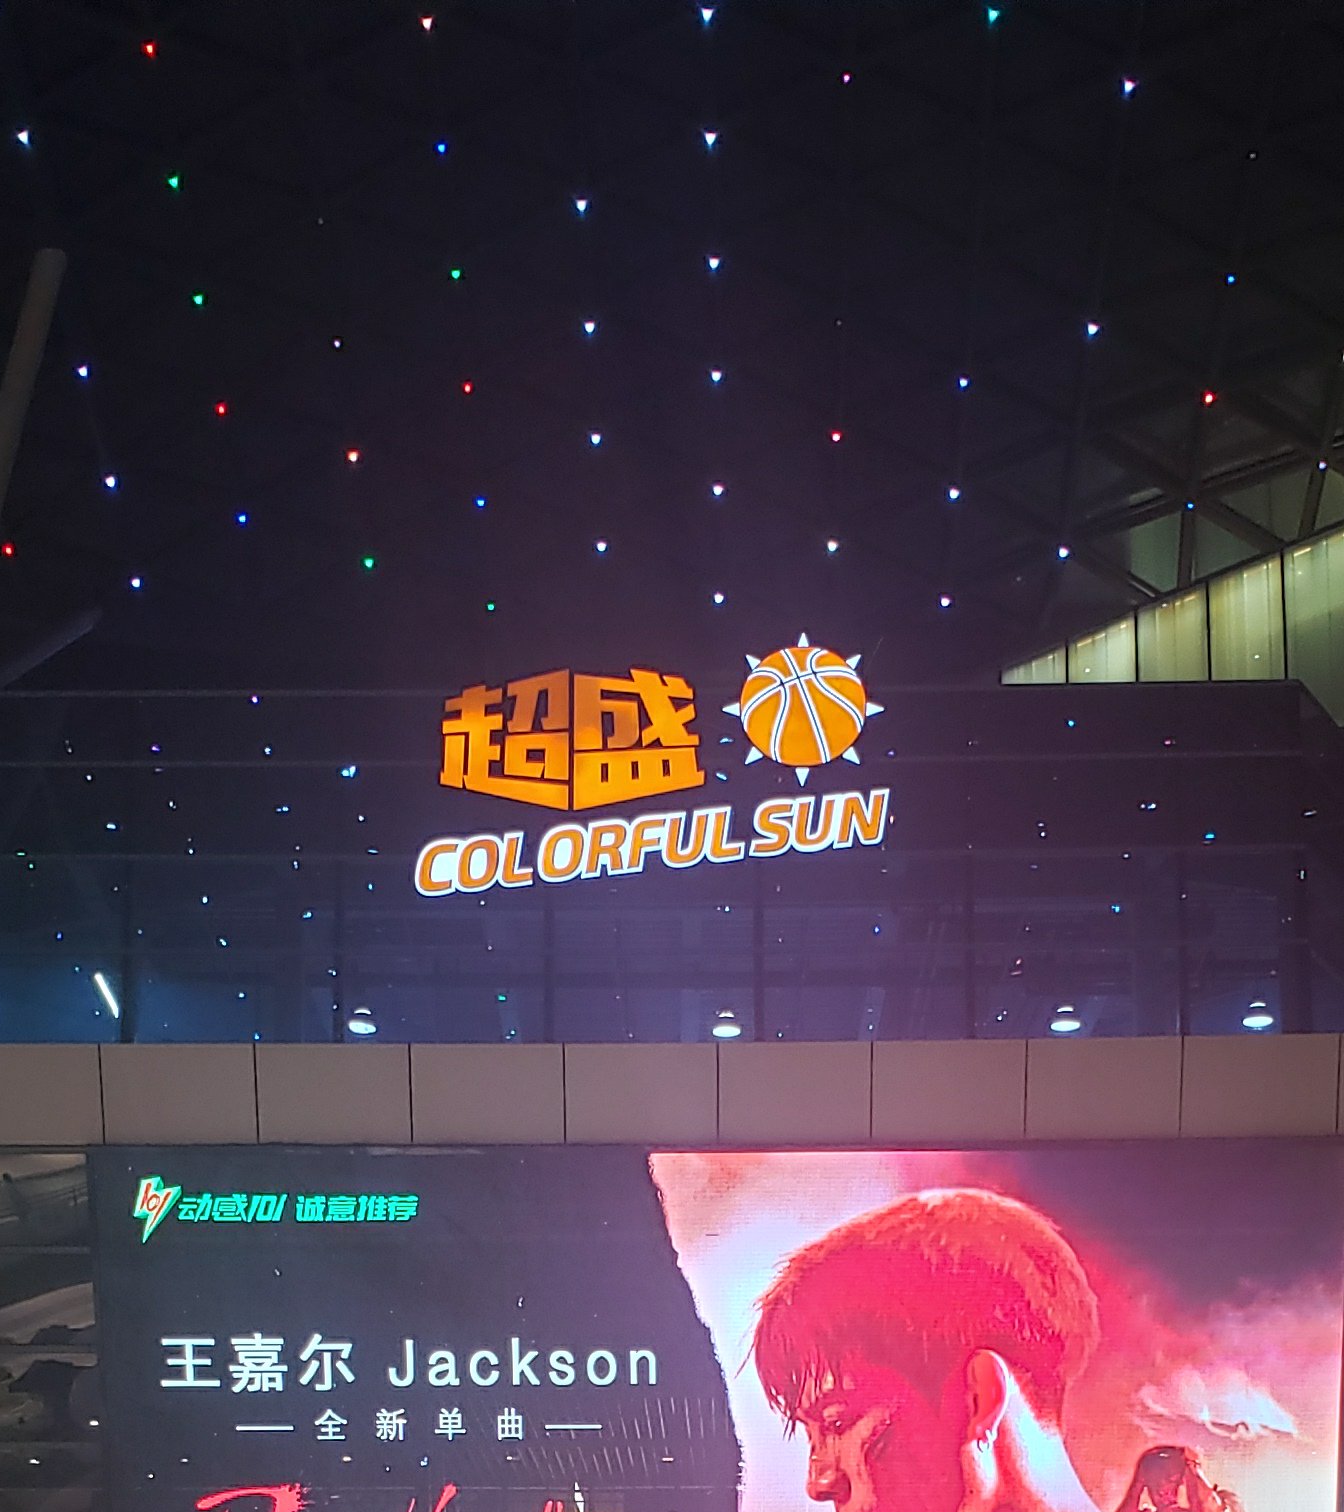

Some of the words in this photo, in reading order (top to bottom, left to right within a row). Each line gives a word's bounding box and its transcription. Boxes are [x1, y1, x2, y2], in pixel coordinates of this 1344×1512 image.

[440, 669, 705, 811] 超盛
[415, 807, 744, 897] COLORFUL
[750, 788, 890, 857] SUN
[178, 1194, 288, 1223] 动感101
[295, 1195, 419, 1222] 诚意推荐
[160, 1334, 355, 1394] 王嘉尔
[388, 1337, 657, 1387] Jackson
[313, 1408, 524, 1442] 全新单曲
